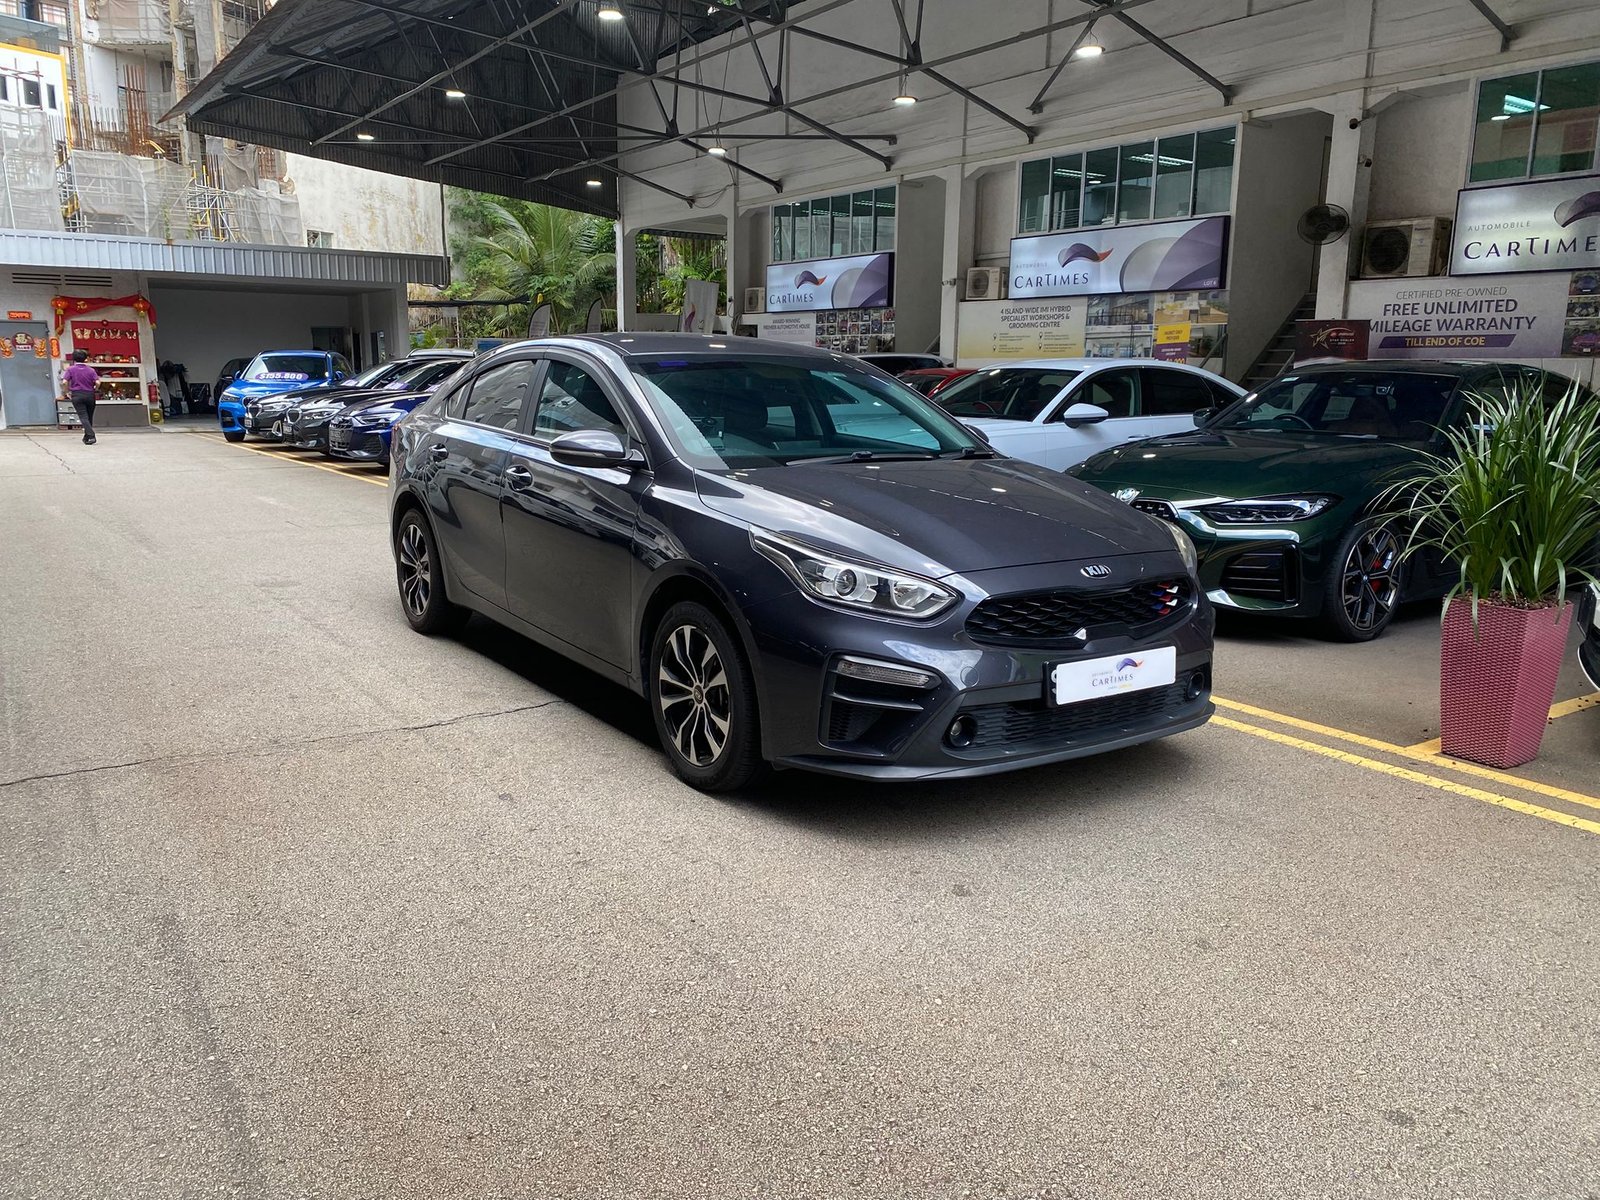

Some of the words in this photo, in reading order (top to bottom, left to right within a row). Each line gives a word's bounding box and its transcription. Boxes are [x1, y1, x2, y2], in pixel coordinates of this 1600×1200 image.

[1468, 221, 1531, 232] AUTOMOBILE
[1014, 272, 1089, 289] CARTIMES
[769, 292, 814, 305] CARTIMES
[1396, 289, 1443, 300] CERTIFIED
[1445, 286, 1508, 298] PRE-OWNED
[1050, 305, 1072, 313] HYBRID
[1383, 302, 1420, 316] FREE
[1423, 299, 1518, 315] UNLIMITED
[1029, 313, 1065, 321] WORKSHOPS
[1436, 316, 1537, 331] WARRANTY
[1405, 338, 1424, 347] TILL
[1425, 337, 1446, 346] END
[1447, 337, 1463, 346] OF
[1463, 336, 1486, 346] COE
[1085, 565, 1109, 576] KIA
[1092, 673, 1134, 687] CARTIMES
